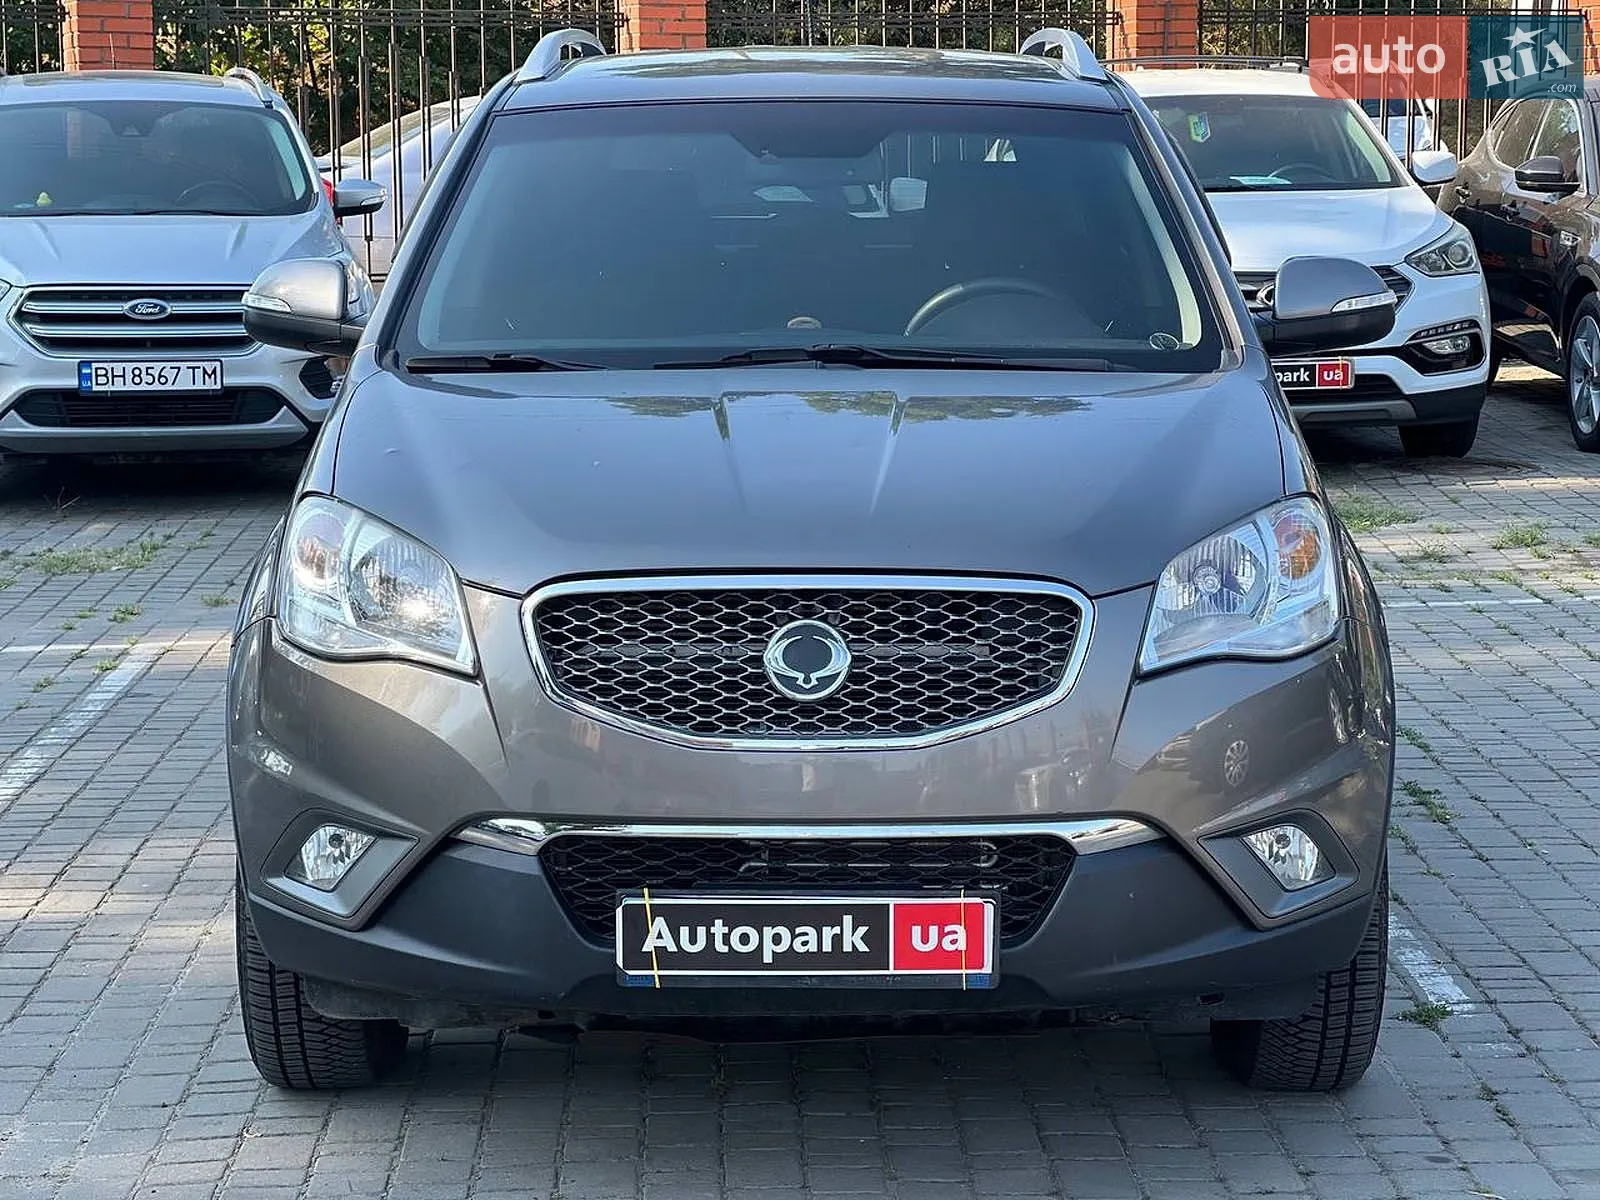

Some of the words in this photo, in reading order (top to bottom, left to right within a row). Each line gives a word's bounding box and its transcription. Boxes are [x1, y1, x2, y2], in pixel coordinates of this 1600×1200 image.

[135, 303, 160, 314] Ford
[94, 366, 126, 386] BH
[131, 366, 181, 386] 8567
[187, 366, 217, 386] TM
[1323, 369, 1343, 381] ua
[641, 914, 870, 964] Autopark
[911, 923, 966, 953] ua
